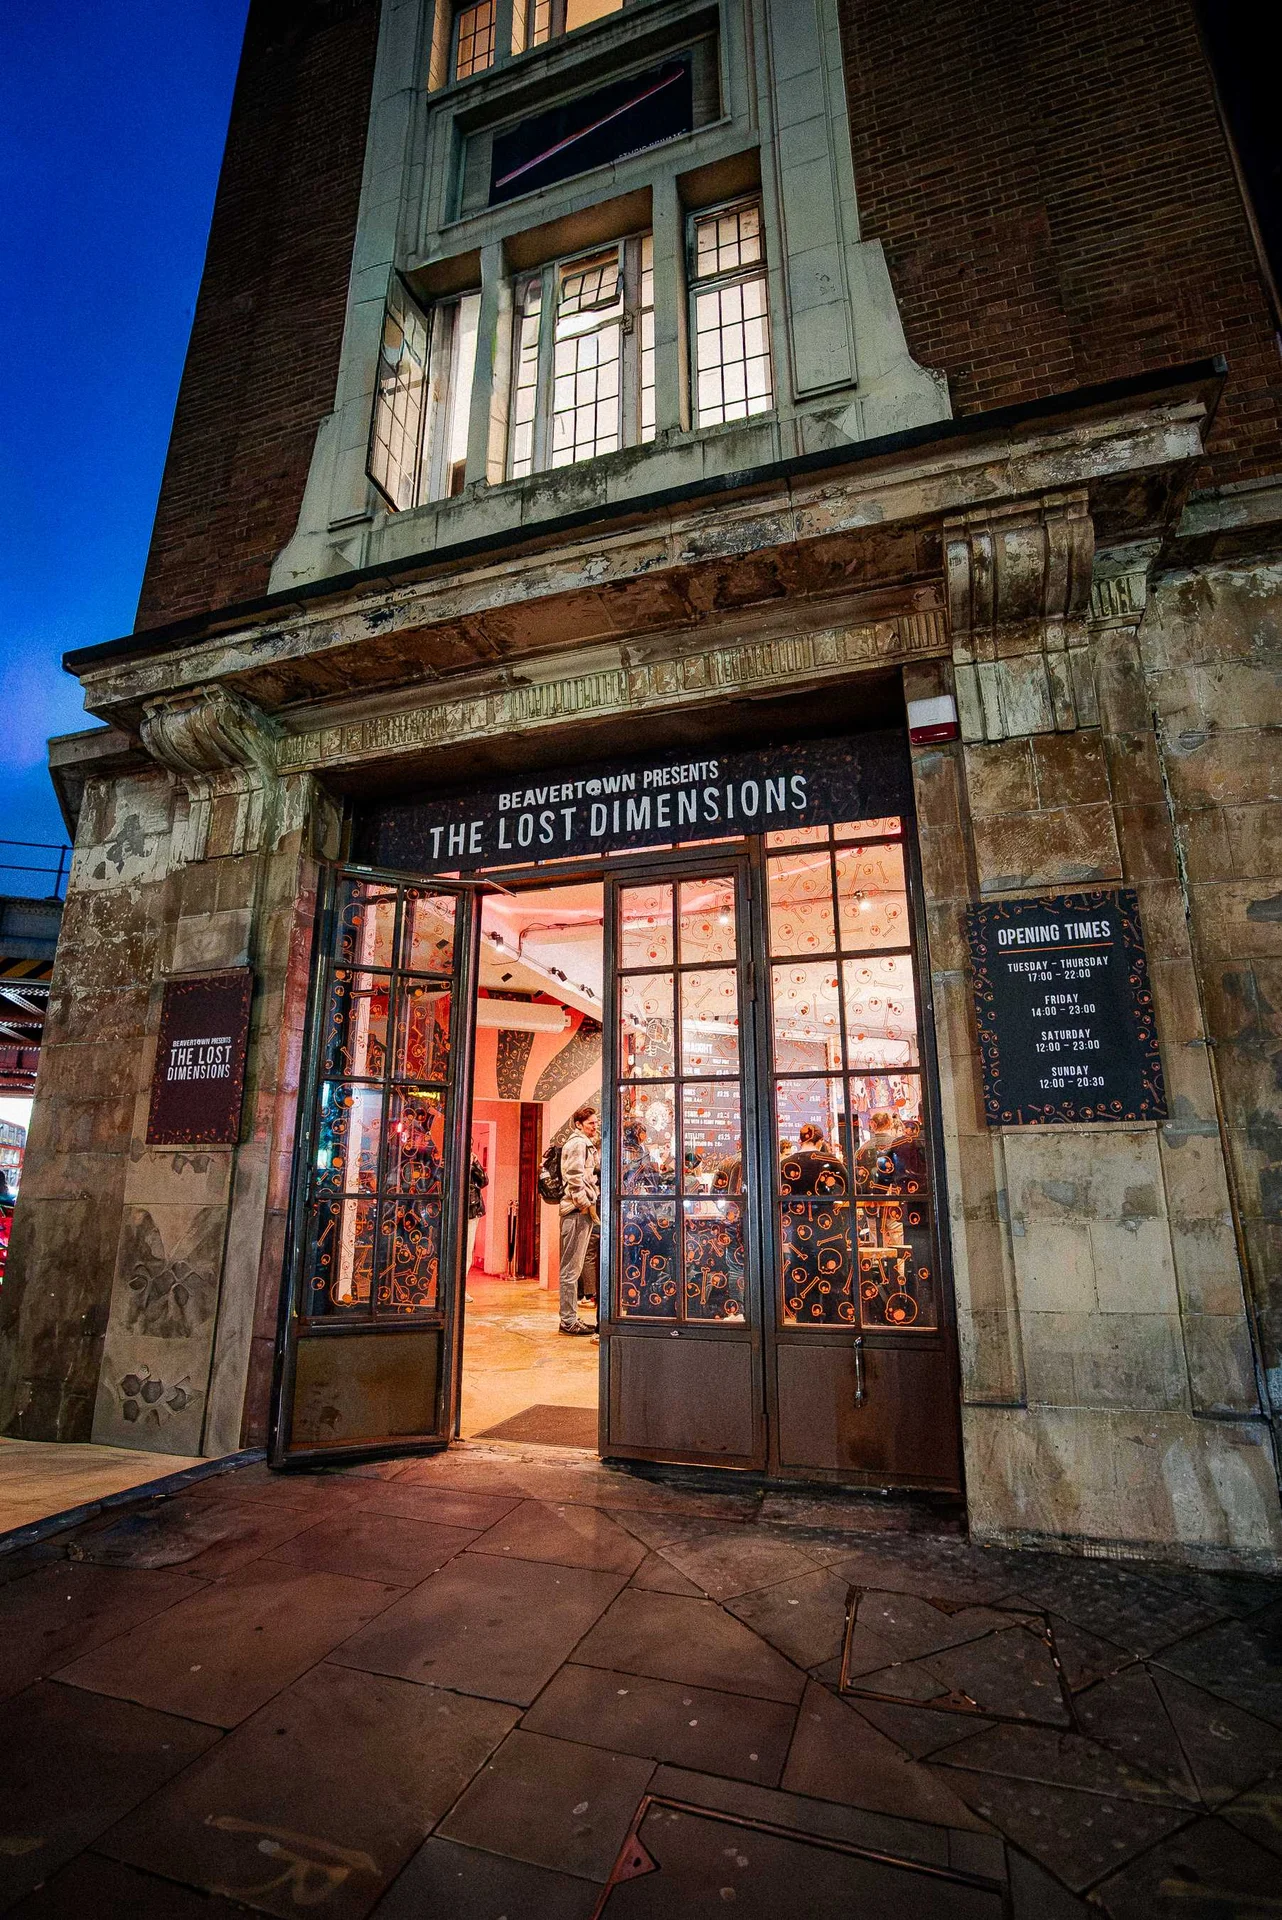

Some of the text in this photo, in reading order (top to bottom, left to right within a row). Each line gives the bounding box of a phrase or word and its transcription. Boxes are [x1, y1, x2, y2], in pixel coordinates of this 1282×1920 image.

[499, 760, 719, 811] BEAVERTOWN PRESENTS
[430, 775, 808, 859] THE LOST DIMENSIONS
[997, 920, 1111, 946] OPENING TIMES
[1007, 961, 1048, 972] TUESDAY
[1060, 956, 1109, 968] THURSDAY
[1028, 972, 1052, 982] 17:00
[1064, 969, 1091, 980] 22:00
[1045, 994, 1079, 1005] FRIDAY
[1031, 1006, 1057, 1017] 14:00
[1069, 1004, 1096, 1015] 23:00
[1041, 1028, 1091, 1041] SATURDAY
[1036, 1042, 1061, 1053] 12:00
[1073, 1040, 1100, 1051] 23:00
[171, 1045, 232, 1066] THE LOST
[167, 1064, 230, 1081] DIMENSIONS
[1051, 1065, 1089, 1077] SUNDAY
[1040, 1078, 1065, 1089] 12:00
[1077, 1076, 1104, 1087] 20:30
